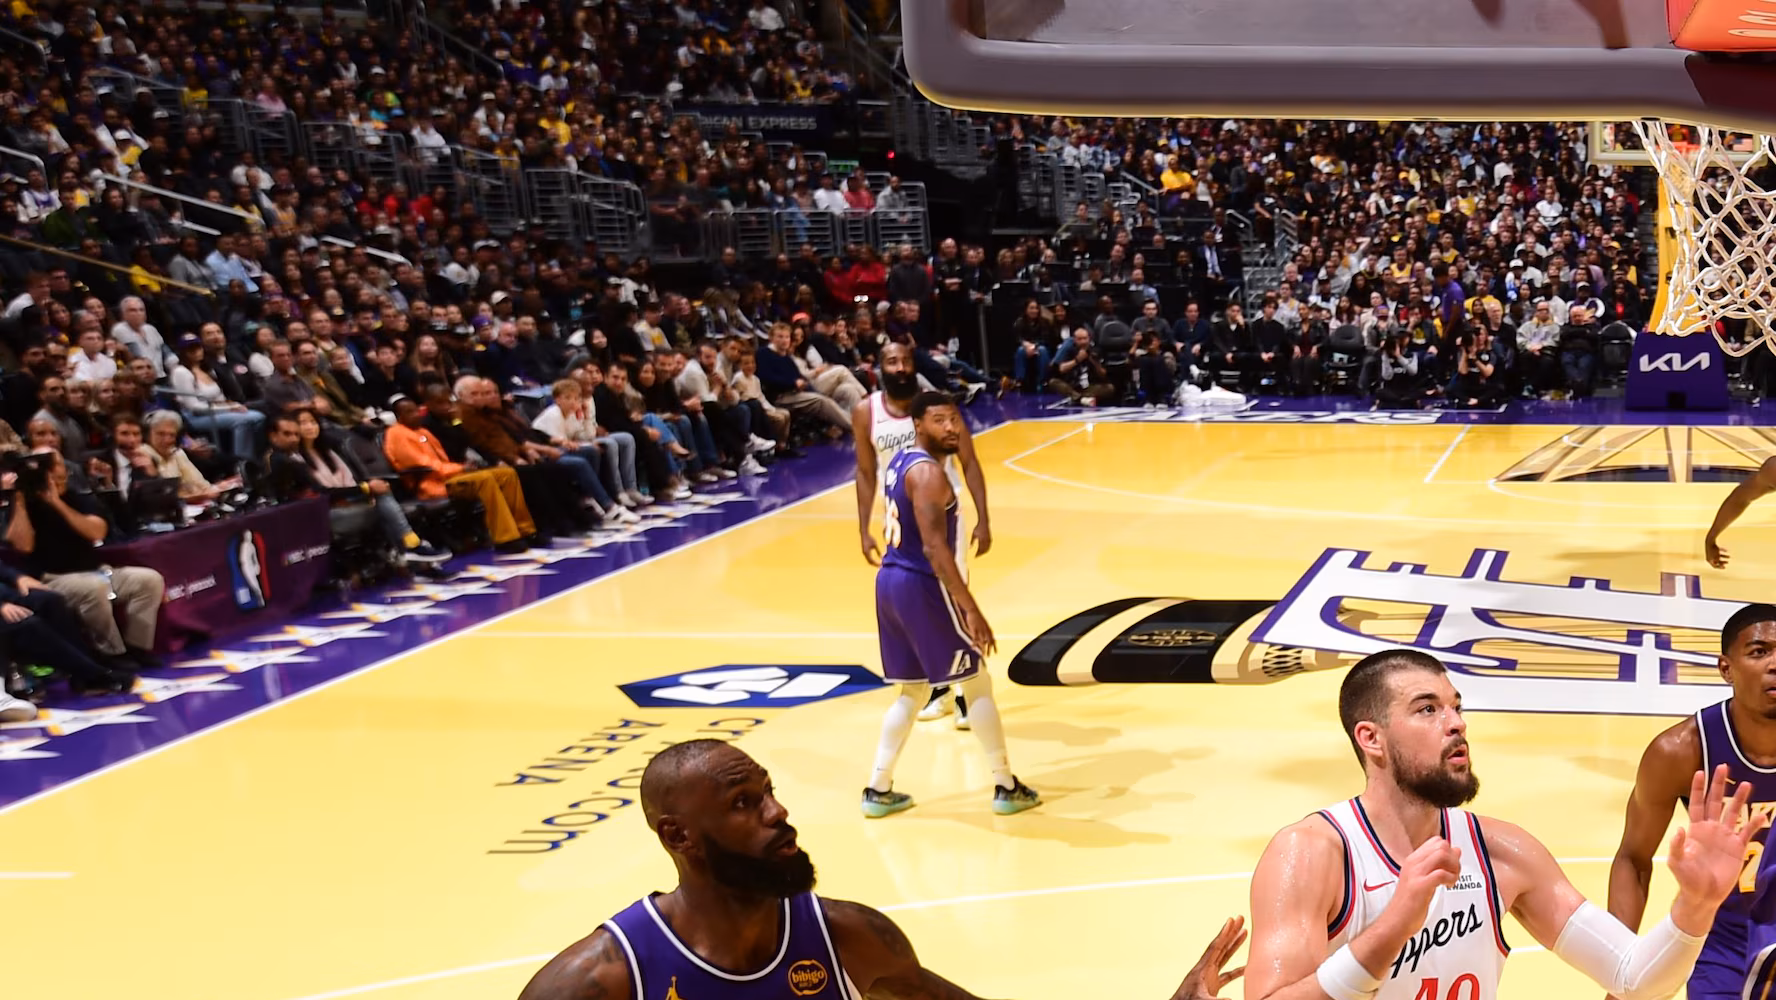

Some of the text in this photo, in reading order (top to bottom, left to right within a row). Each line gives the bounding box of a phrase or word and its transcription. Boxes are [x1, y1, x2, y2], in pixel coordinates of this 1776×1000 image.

[748, 116, 817, 130] EXPRESS
[1638, 351, 1711, 373] KIA
[877, 430, 917, 453] Clippe
[494, 717, 668, 788] ARENA
[791, 969, 824, 985] bibigo
